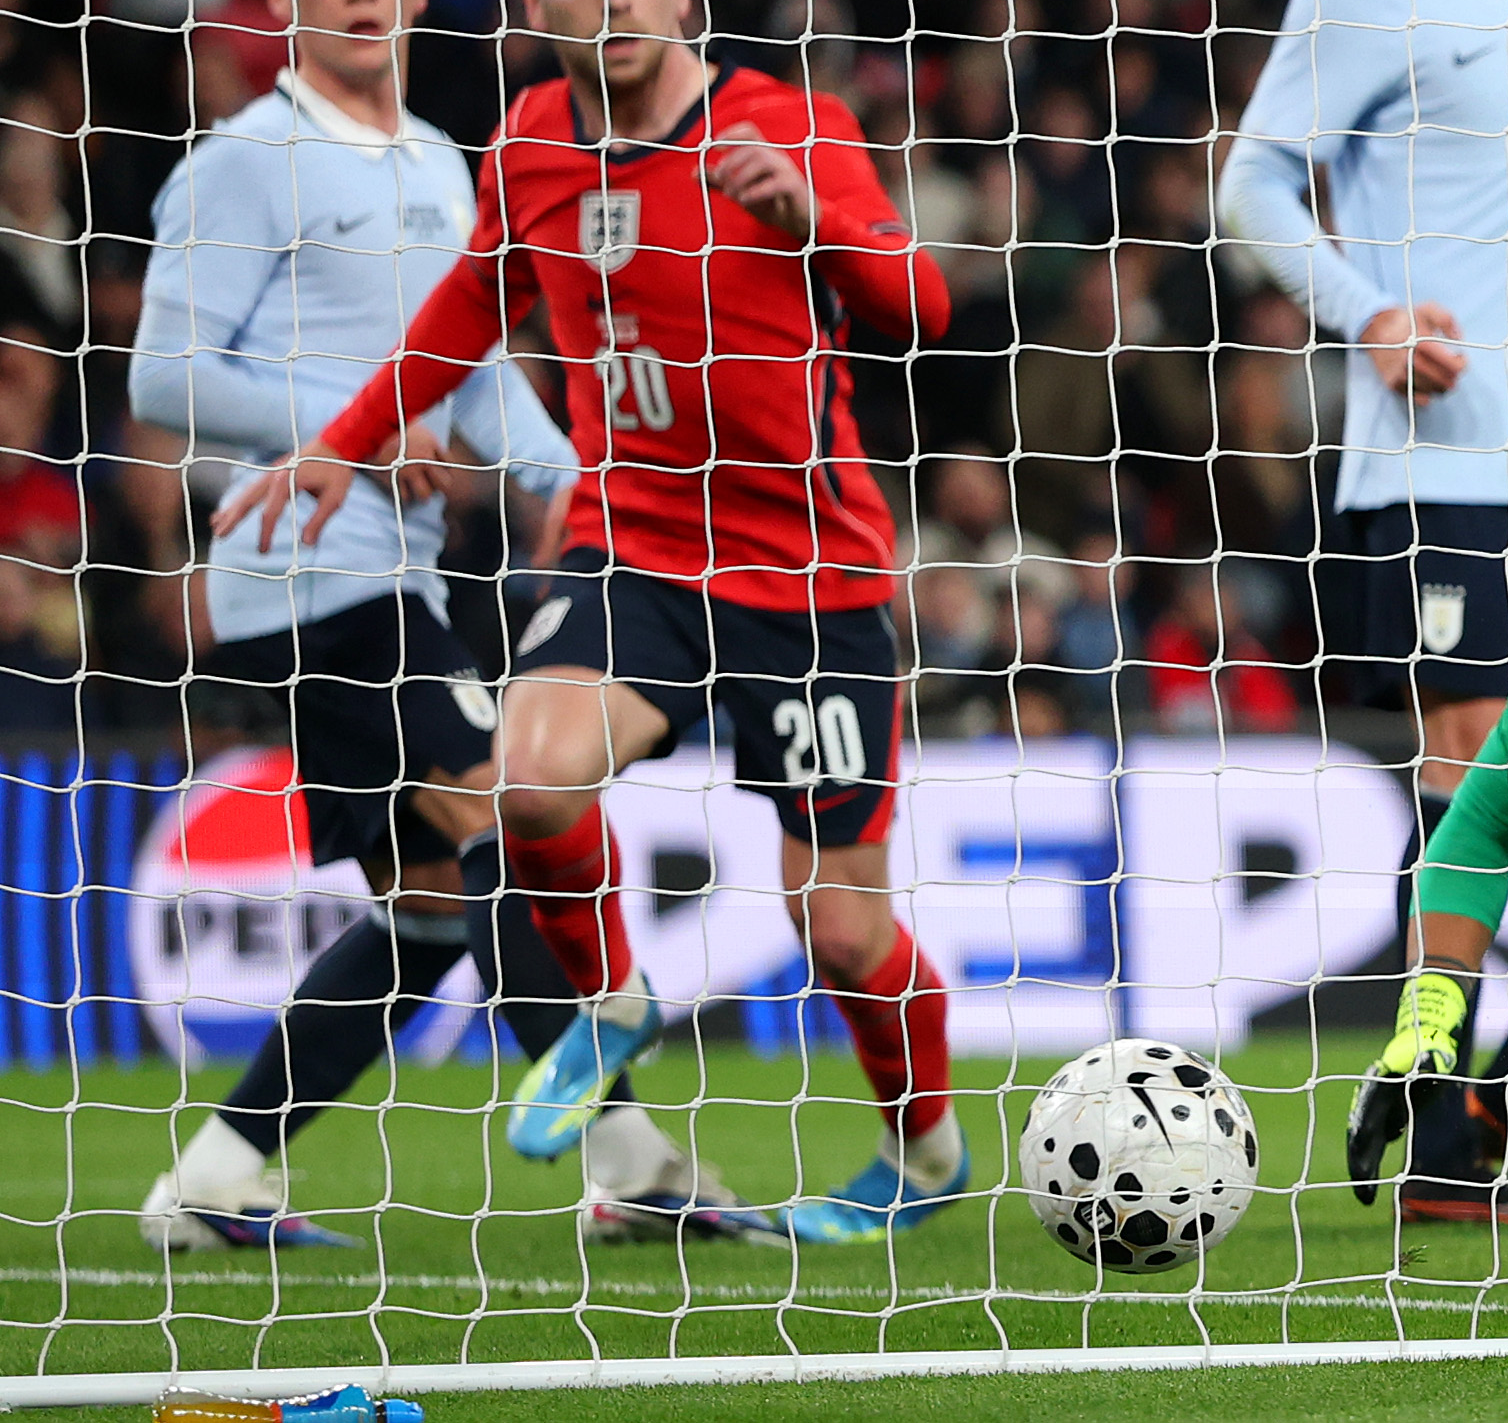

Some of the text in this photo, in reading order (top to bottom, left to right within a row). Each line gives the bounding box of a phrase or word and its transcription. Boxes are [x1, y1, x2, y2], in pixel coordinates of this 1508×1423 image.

[594, 344, 675, 432] 20
[772, 694, 867, 789] 20
[162, 899, 352, 962] PEP
